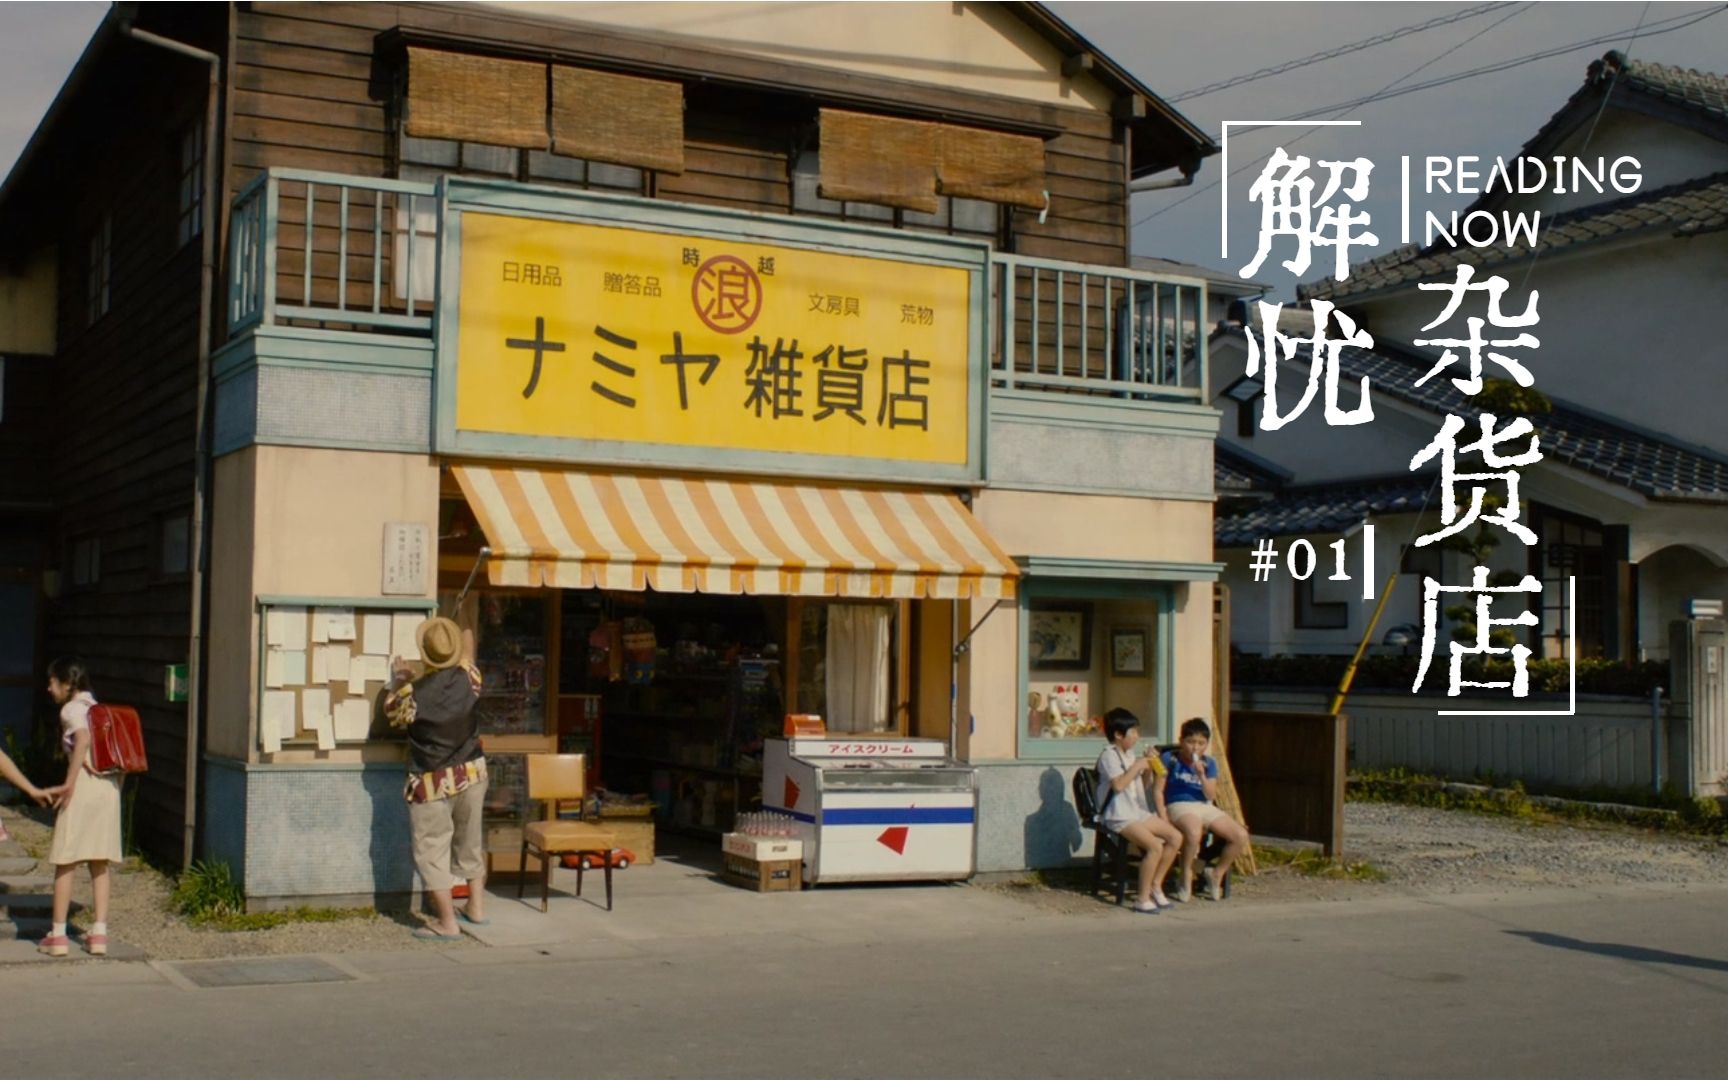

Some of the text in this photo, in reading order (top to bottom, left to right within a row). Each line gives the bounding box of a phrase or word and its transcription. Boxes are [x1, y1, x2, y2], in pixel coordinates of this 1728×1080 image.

[502, 262, 934, 326] 日用品 贈答品 文房具 荒物
[682, 247, 775, 321] 時 浪 越
[505, 315, 931, 432] ナミヤ雑貨店
[828, 744, 914, 754] アイスクリーム
